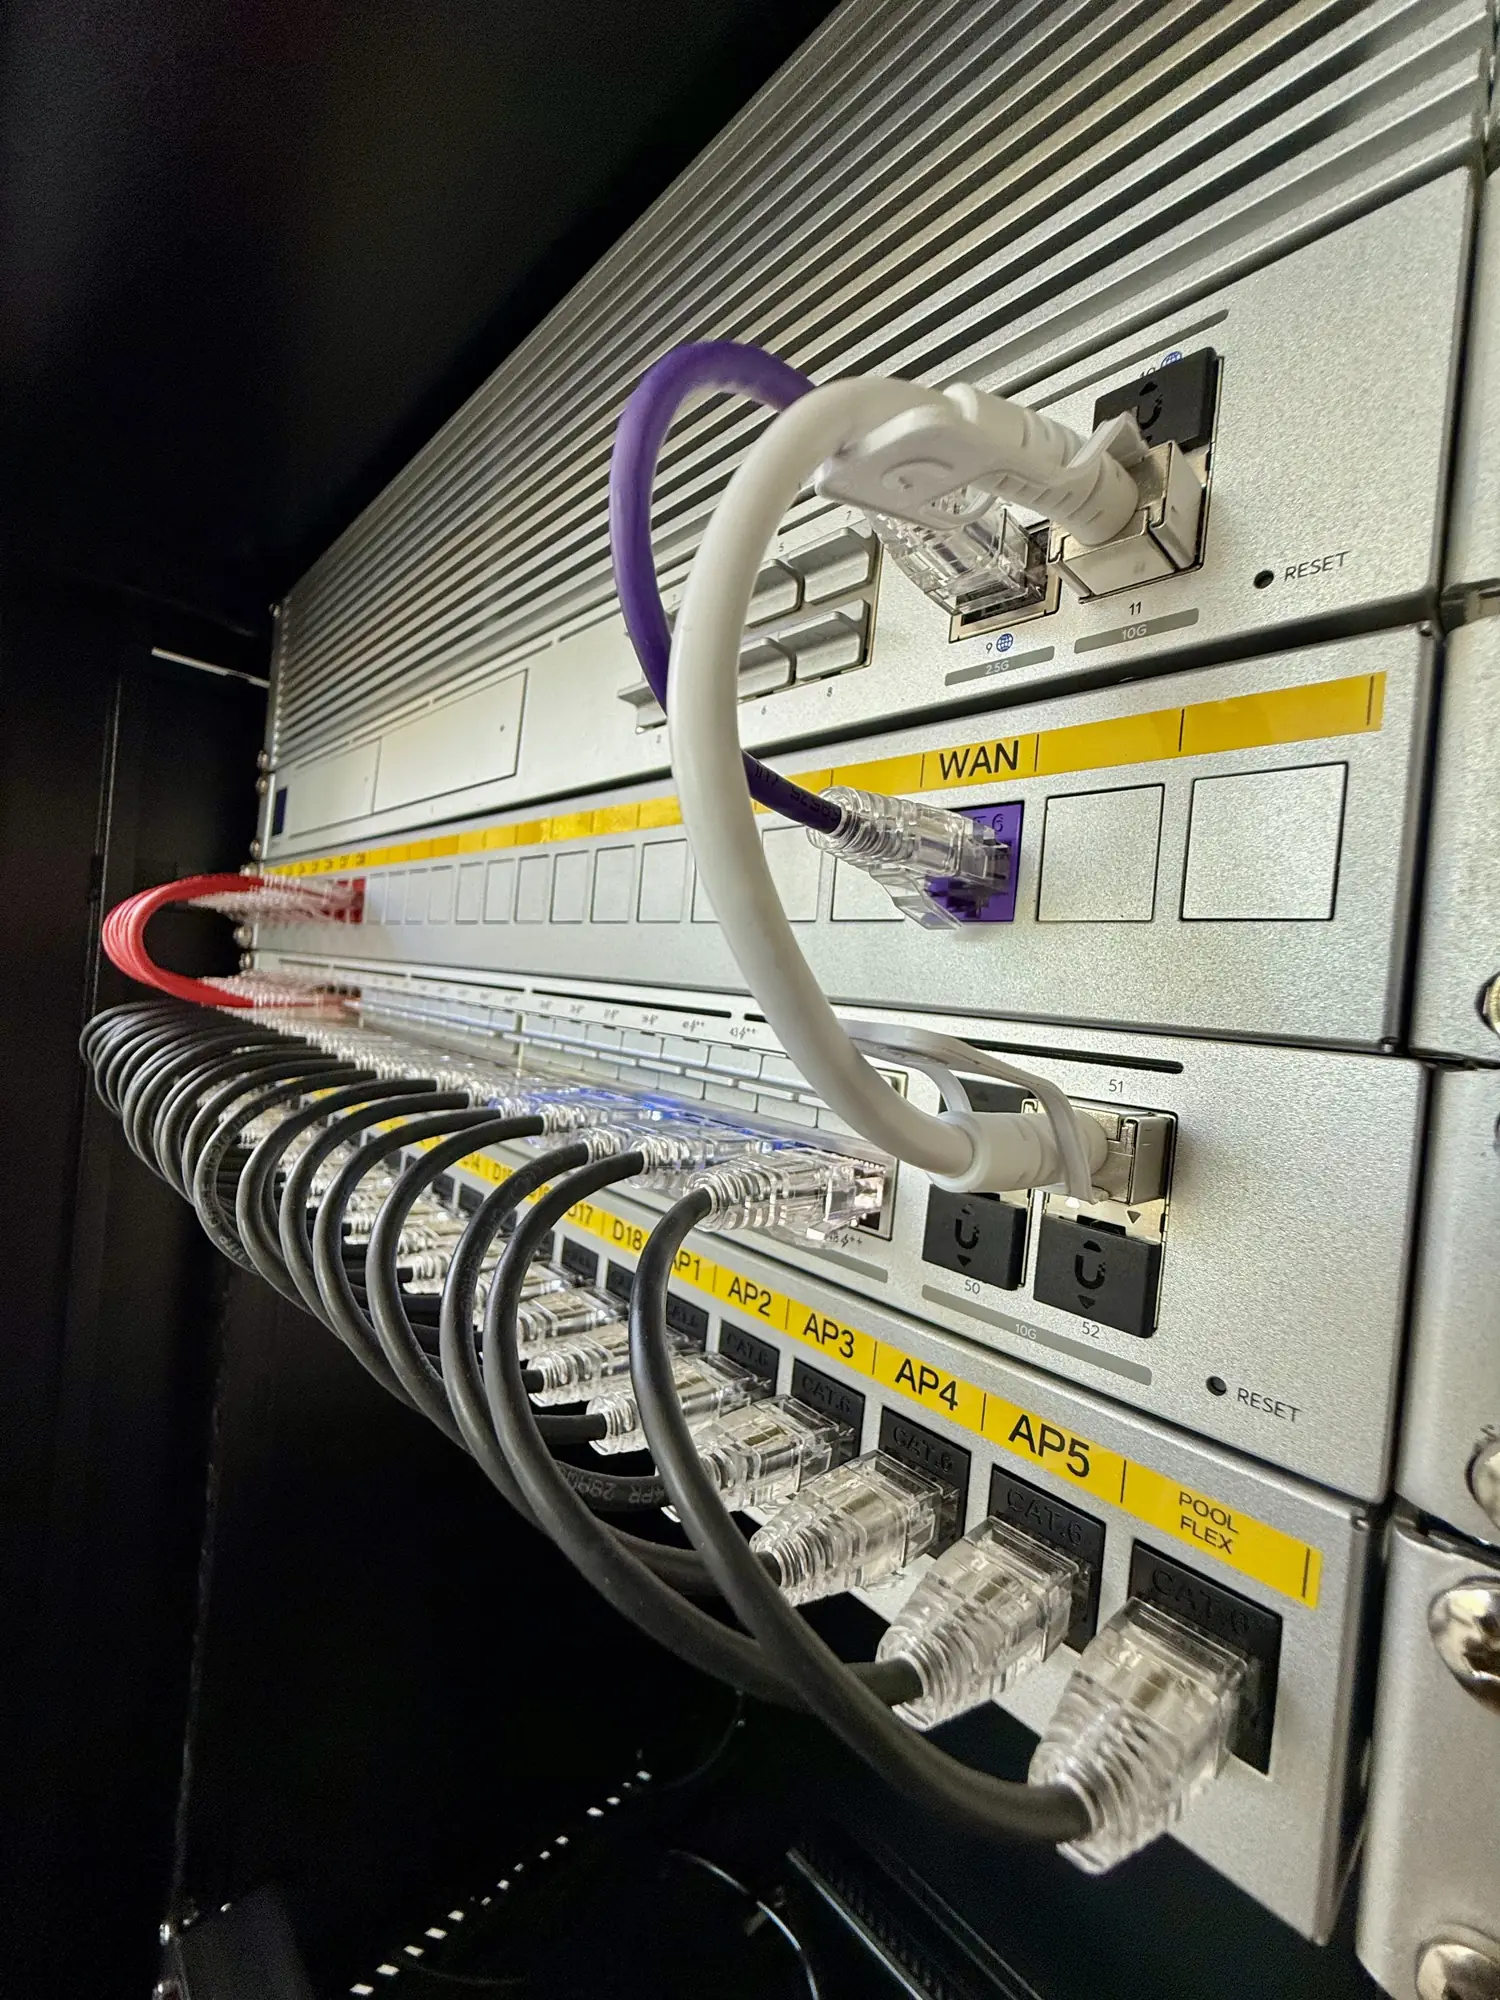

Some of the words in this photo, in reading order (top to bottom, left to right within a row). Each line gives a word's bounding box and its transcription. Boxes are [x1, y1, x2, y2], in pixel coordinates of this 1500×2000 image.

[1284, 551, 1349, 582] RESET
[1129, 602, 1142, 616] 11
[985, 642, 993, 653] 9
[1121, 625, 1148, 640] 10G
[939, 740, 1019, 781] WAN
[1108, 1079, 1124, 1093] 51
[613, 1220, 643, 1251] D18
[728, 1276, 772, 1317] AP2
[964, 1280, 981, 1295] 50
[803, 1313, 856, 1359] AP3
[1014, 1323, 1037, 1341] 10G
[1082, 1321, 1100, 1338] 52
[894, 1358, 958, 1411] AP4
[1237, 1388, 1301, 1423] RESET
[1009, 1415, 1090, 1478] AP5
[1007, 1488, 1083, 1546] CAT.6
[1178, 1491, 1239, 1534] POOL
[1180, 1514, 1233, 1554] FLEX
